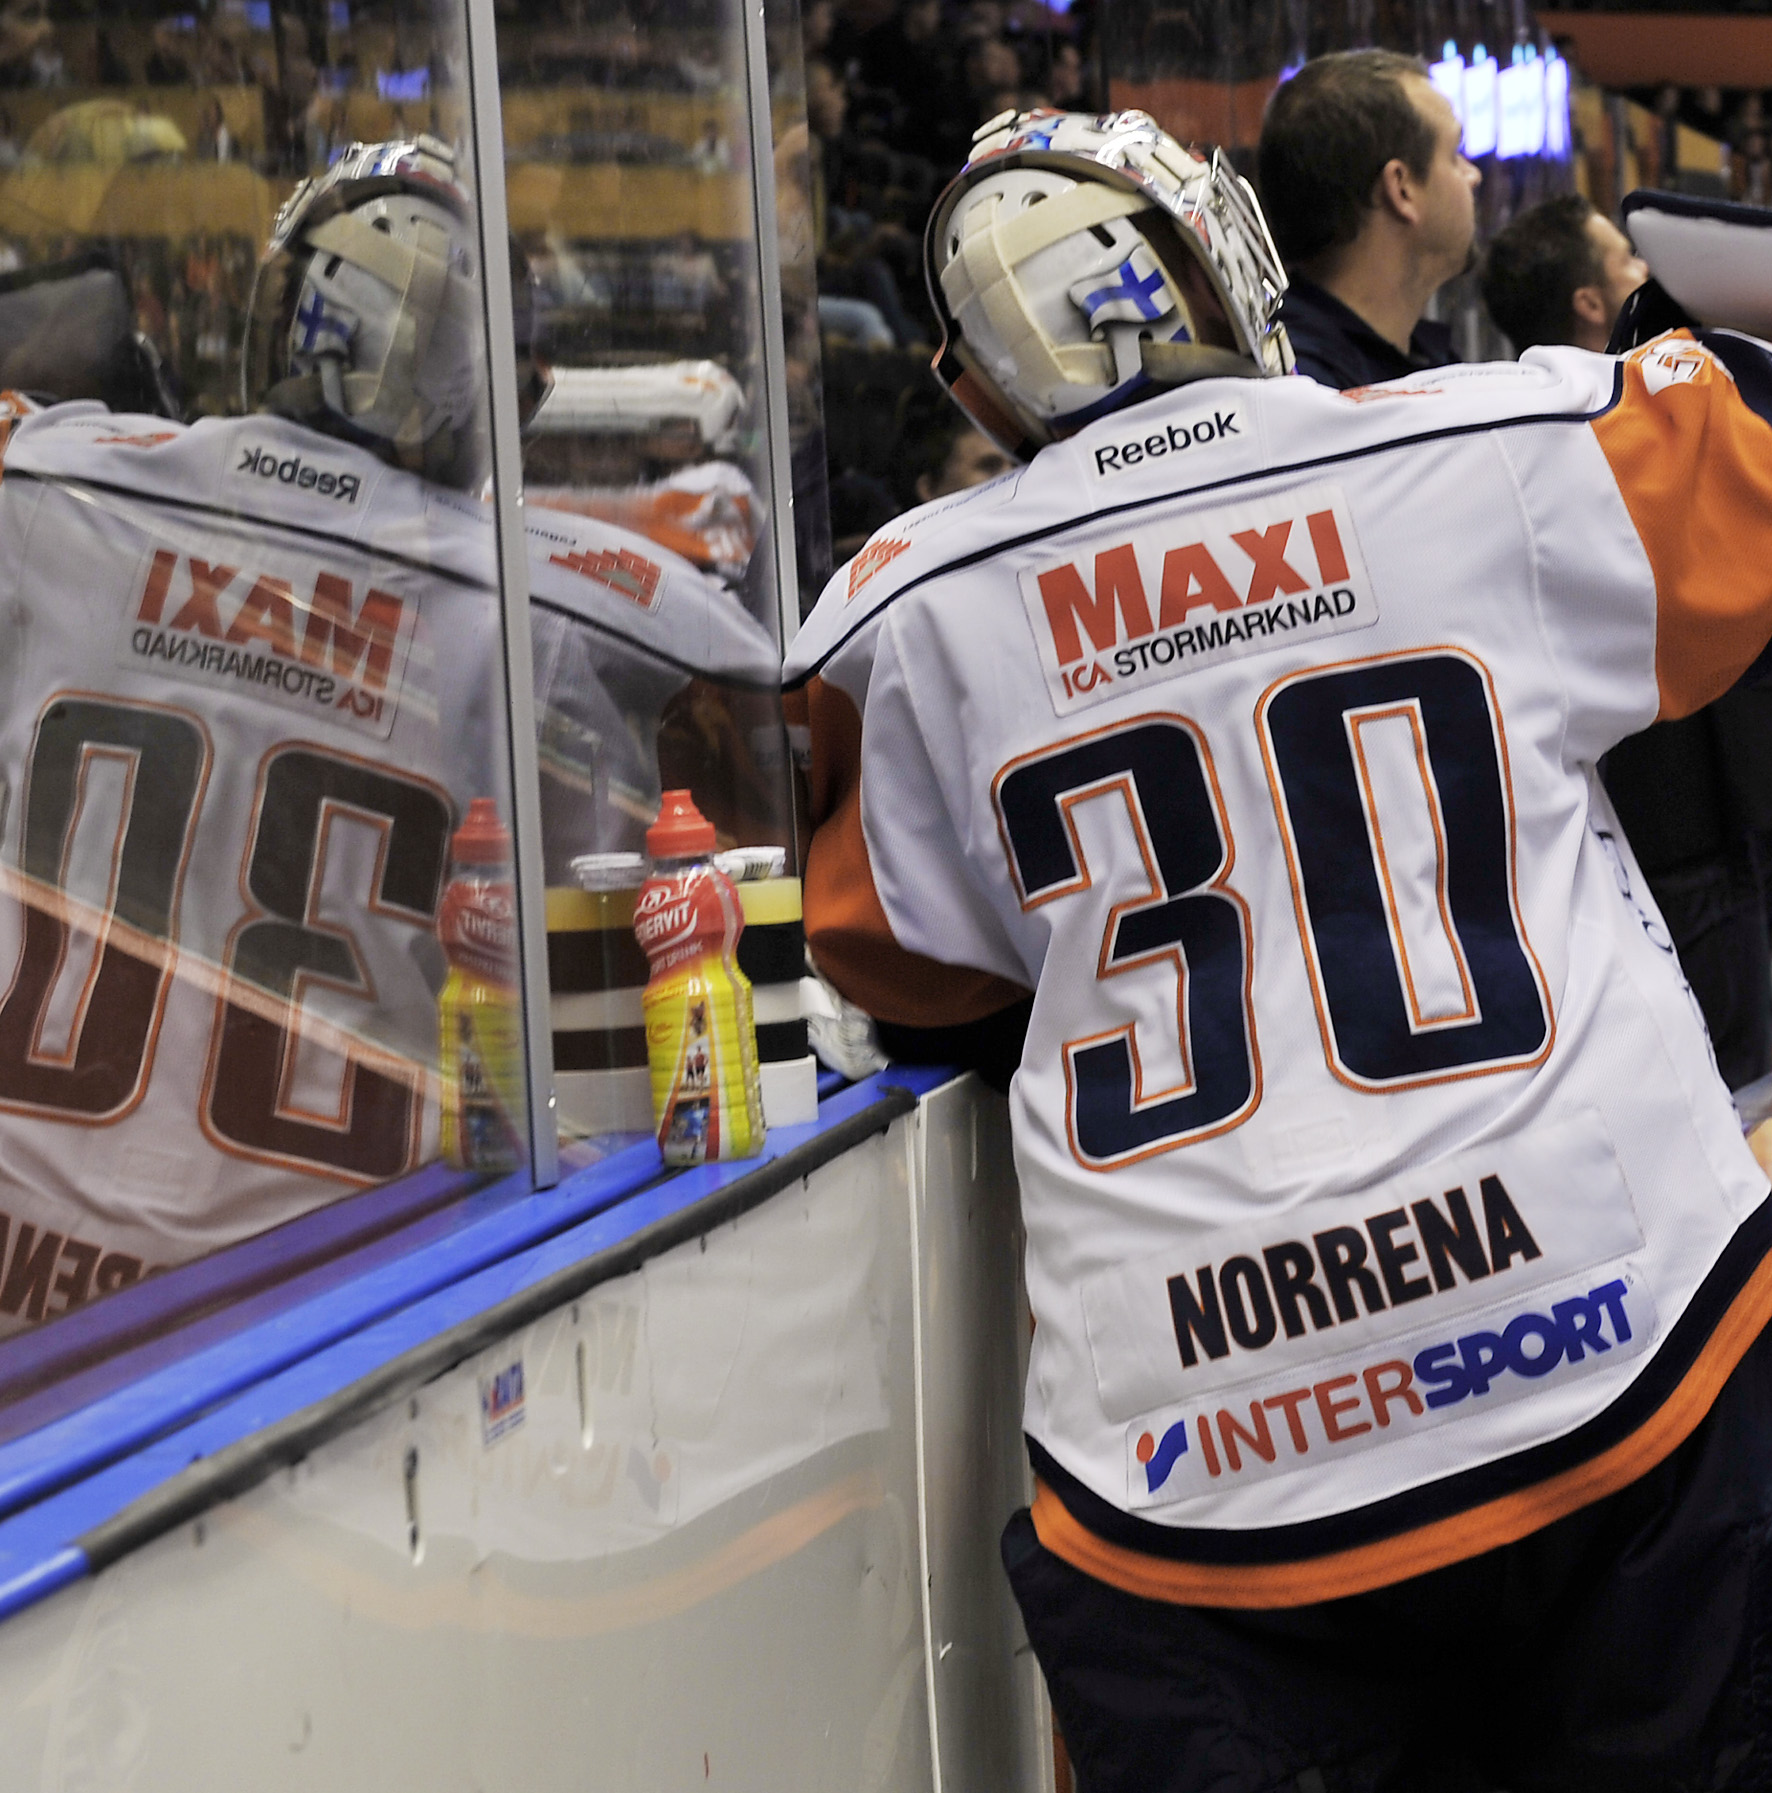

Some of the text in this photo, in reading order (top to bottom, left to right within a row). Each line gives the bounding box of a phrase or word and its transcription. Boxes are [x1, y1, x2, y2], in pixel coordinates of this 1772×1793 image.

[1094, 410, 1241, 477] Reebok
[1037, 508, 1350, 668] MAXI
[1060, 588, 1357, 699] ICA STORMARKNAD
[990, 644, 1557, 1172] 30
[1166, 1173, 1543, 1370] NORRENA
[1197, 1278, 1634, 1478] INTERSPORT
